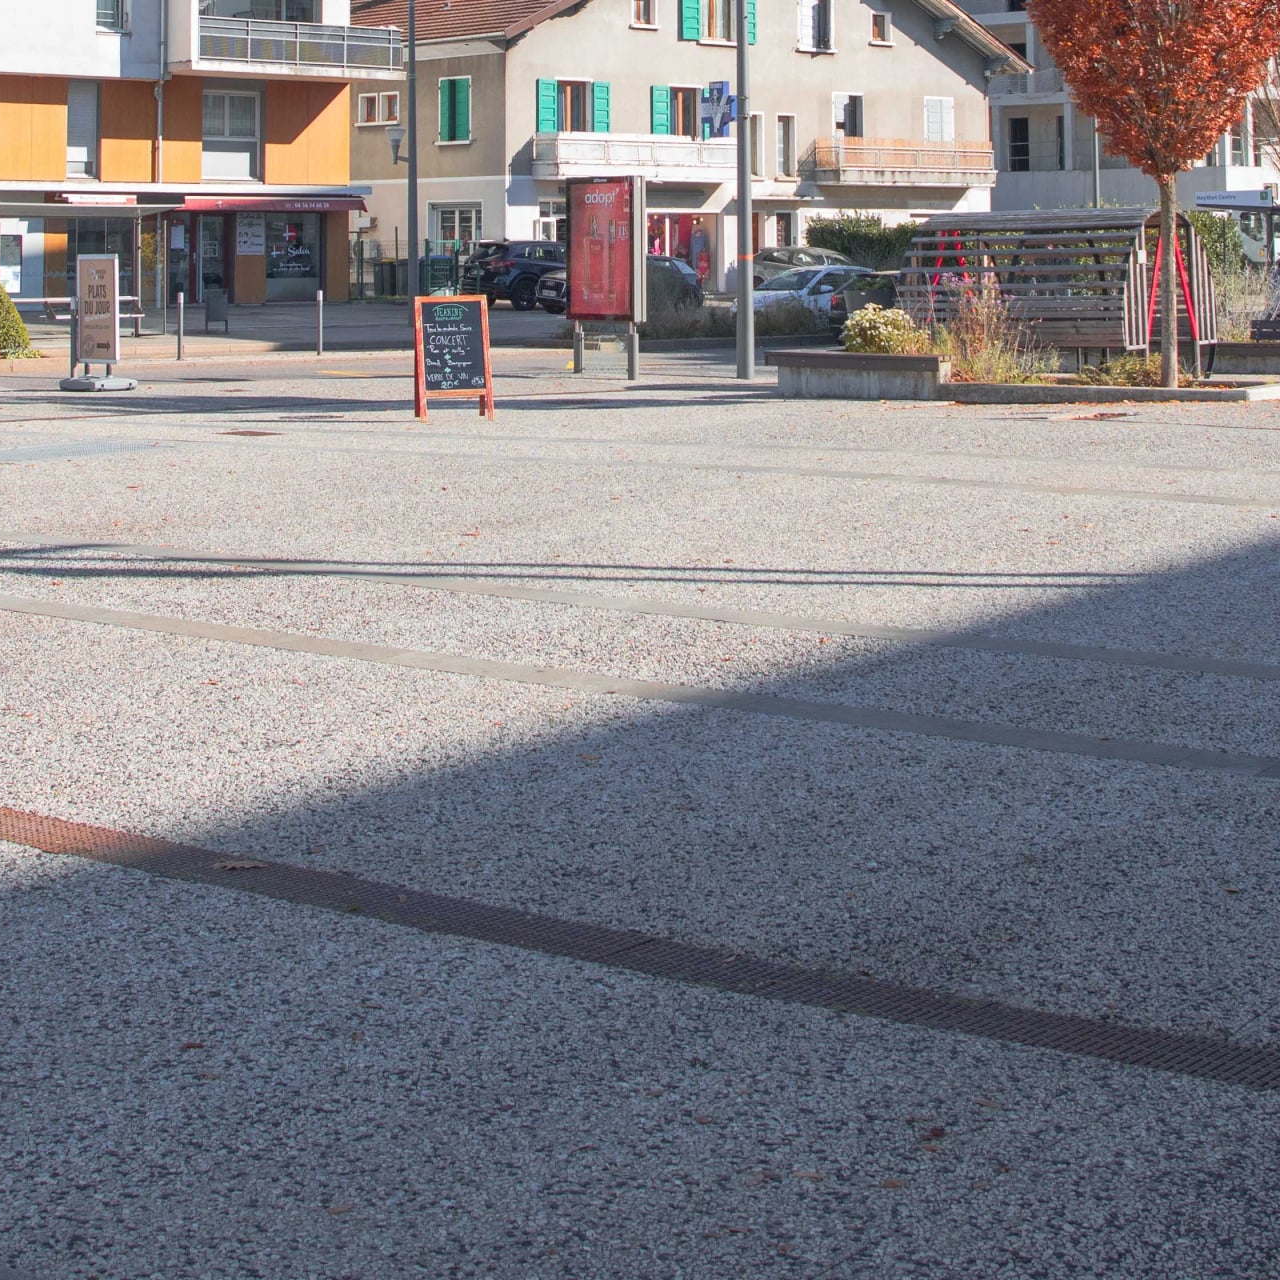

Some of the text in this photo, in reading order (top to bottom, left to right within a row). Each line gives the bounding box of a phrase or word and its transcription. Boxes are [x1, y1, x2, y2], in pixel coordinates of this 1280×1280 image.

[88, 285, 106, 298] PLATS
[84, 301, 93, 314] DU
[429, 335, 469, 346] CONCERT
